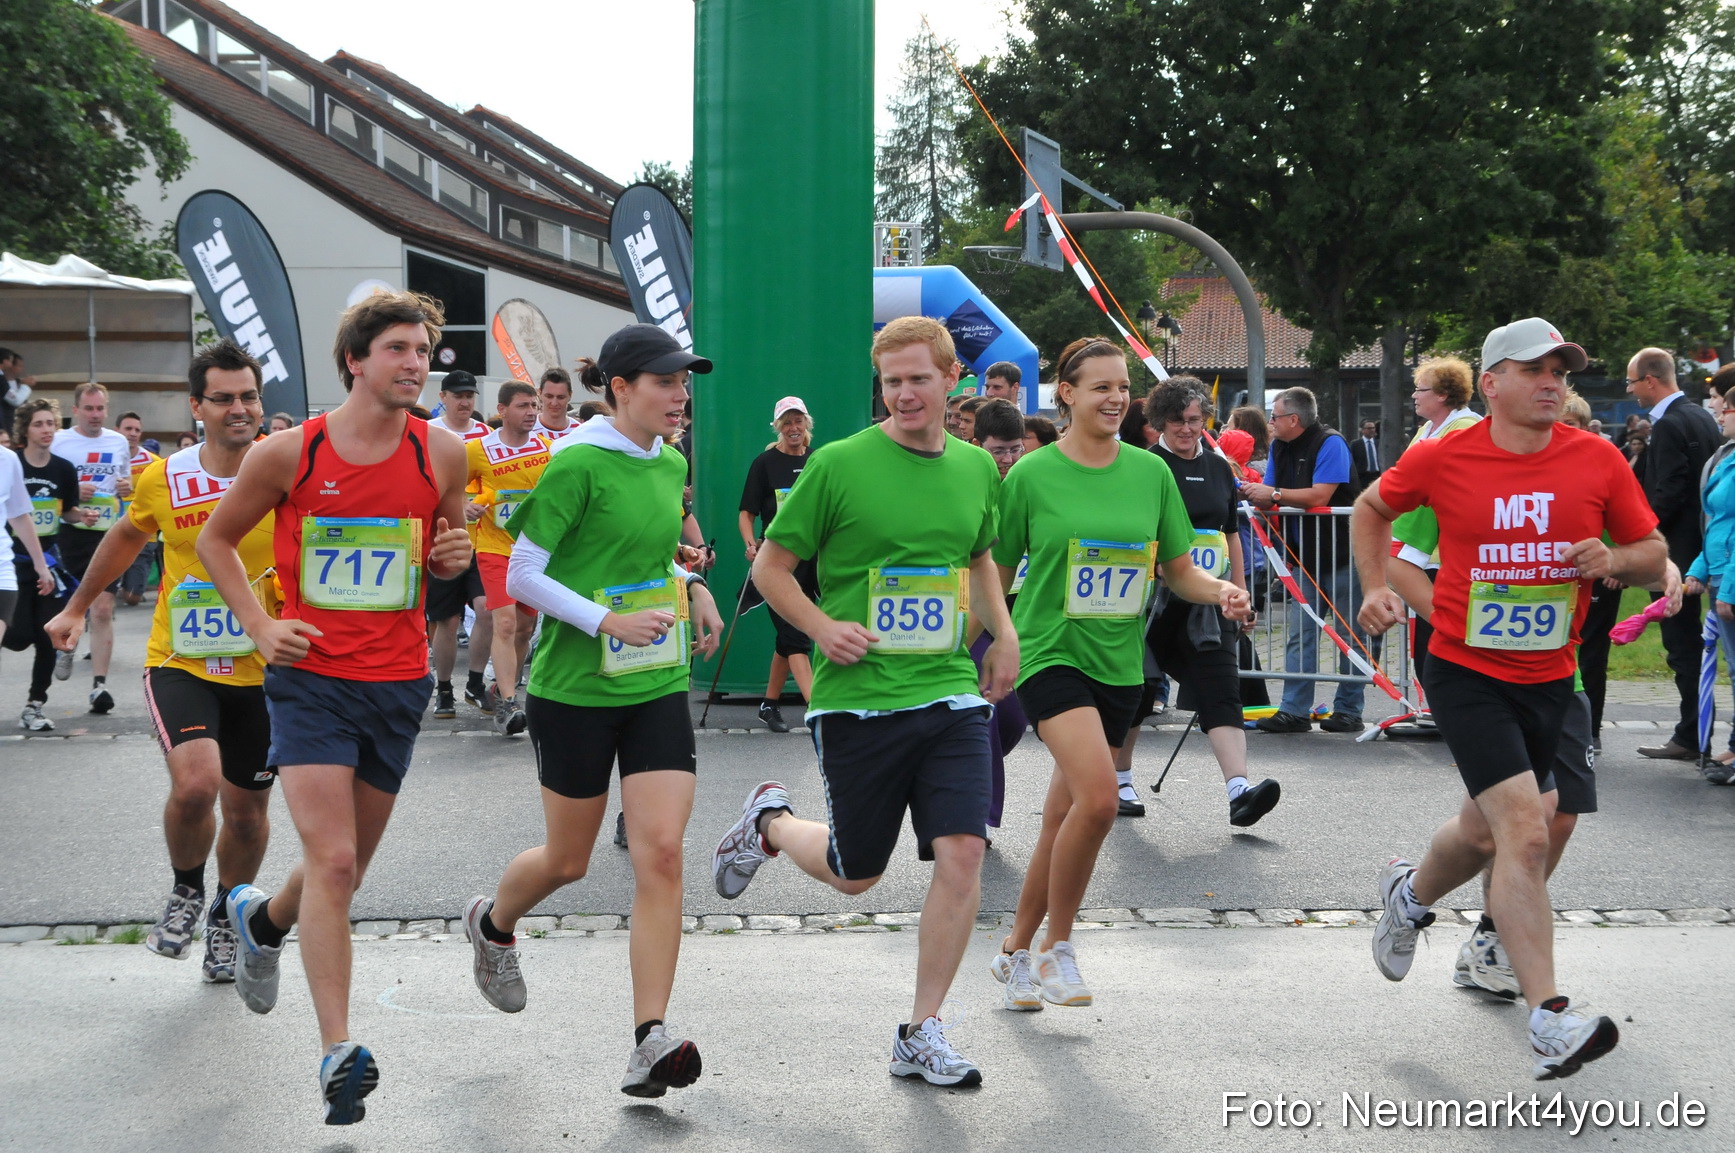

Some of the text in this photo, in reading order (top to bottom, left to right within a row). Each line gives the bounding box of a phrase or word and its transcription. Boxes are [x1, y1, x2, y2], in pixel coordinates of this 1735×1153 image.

[76, 464, 116, 475] PERRAS
[492, 462, 520, 478] MAX
[174, 508, 214, 530] MA
[1493, 492, 1555, 536] MRT
[315, 549, 396, 586] 717
[1470, 565, 1580, 581] Running Team
[328, 587, 358, 596] Marco
[1076, 566, 1139, 598] 817
[180, 608, 244, 638] 450
[876, 598, 944, 632] 858
[1479, 603, 1556, 638] 259
[890, 632, 916, 641] Daniel
[1492, 638, 1530, 647] Eckhard
[616, 651, 644, 662] Barbara
